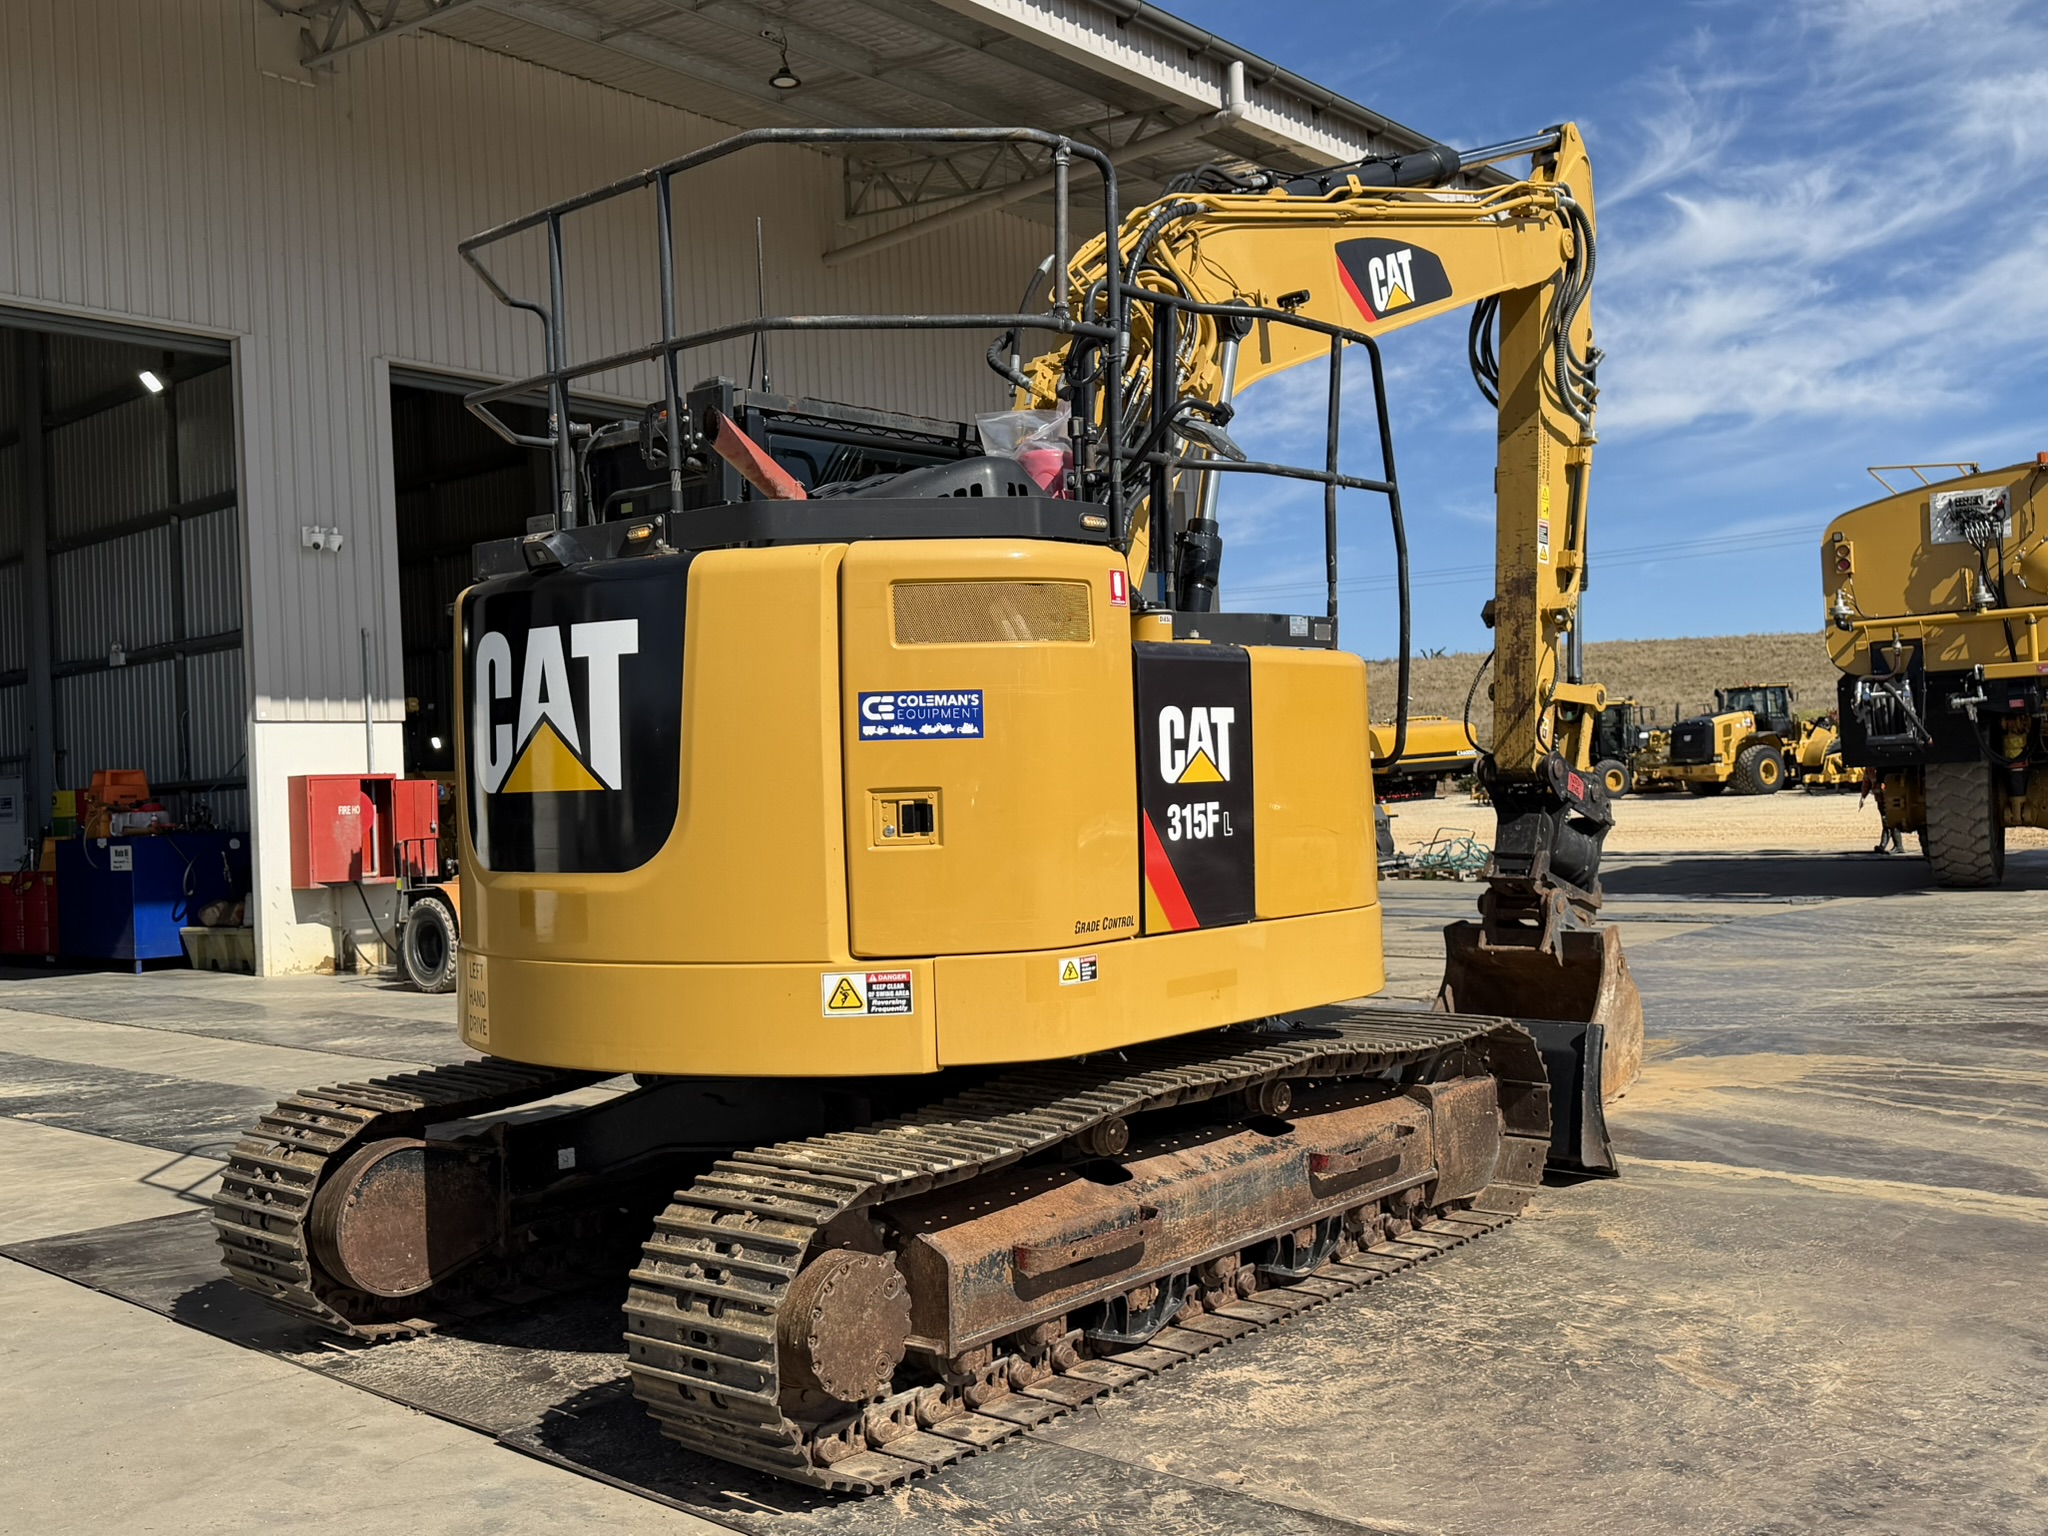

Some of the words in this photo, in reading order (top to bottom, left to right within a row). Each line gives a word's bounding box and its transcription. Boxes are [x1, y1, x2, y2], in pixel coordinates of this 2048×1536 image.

[1368, 248, 1416, 313] CAT
[475, 618, 639, 795] CAT
[897, 693, 980, 707] COLEMAN'S
[897, 707, 980, 720] EQUIPMENT
[1158, 705, 1235, 784] CAT
[337, 805, 351, 815] FIRE
[1167, 801, 1220, 842] 315F
[1223, 811, 1233, 837] L
[469, 961, 484, 980] LEFT
[877, 973, 907, 981] DANGER
[887, 982, 905, 990] CLEAR
[468, 987, 487, 1008] HAND
[871, 998, 907, 1006] Reversing
[870, 1005, 909, 1013] Frequently
[469, 1014, 488, 1036] DRIVE
